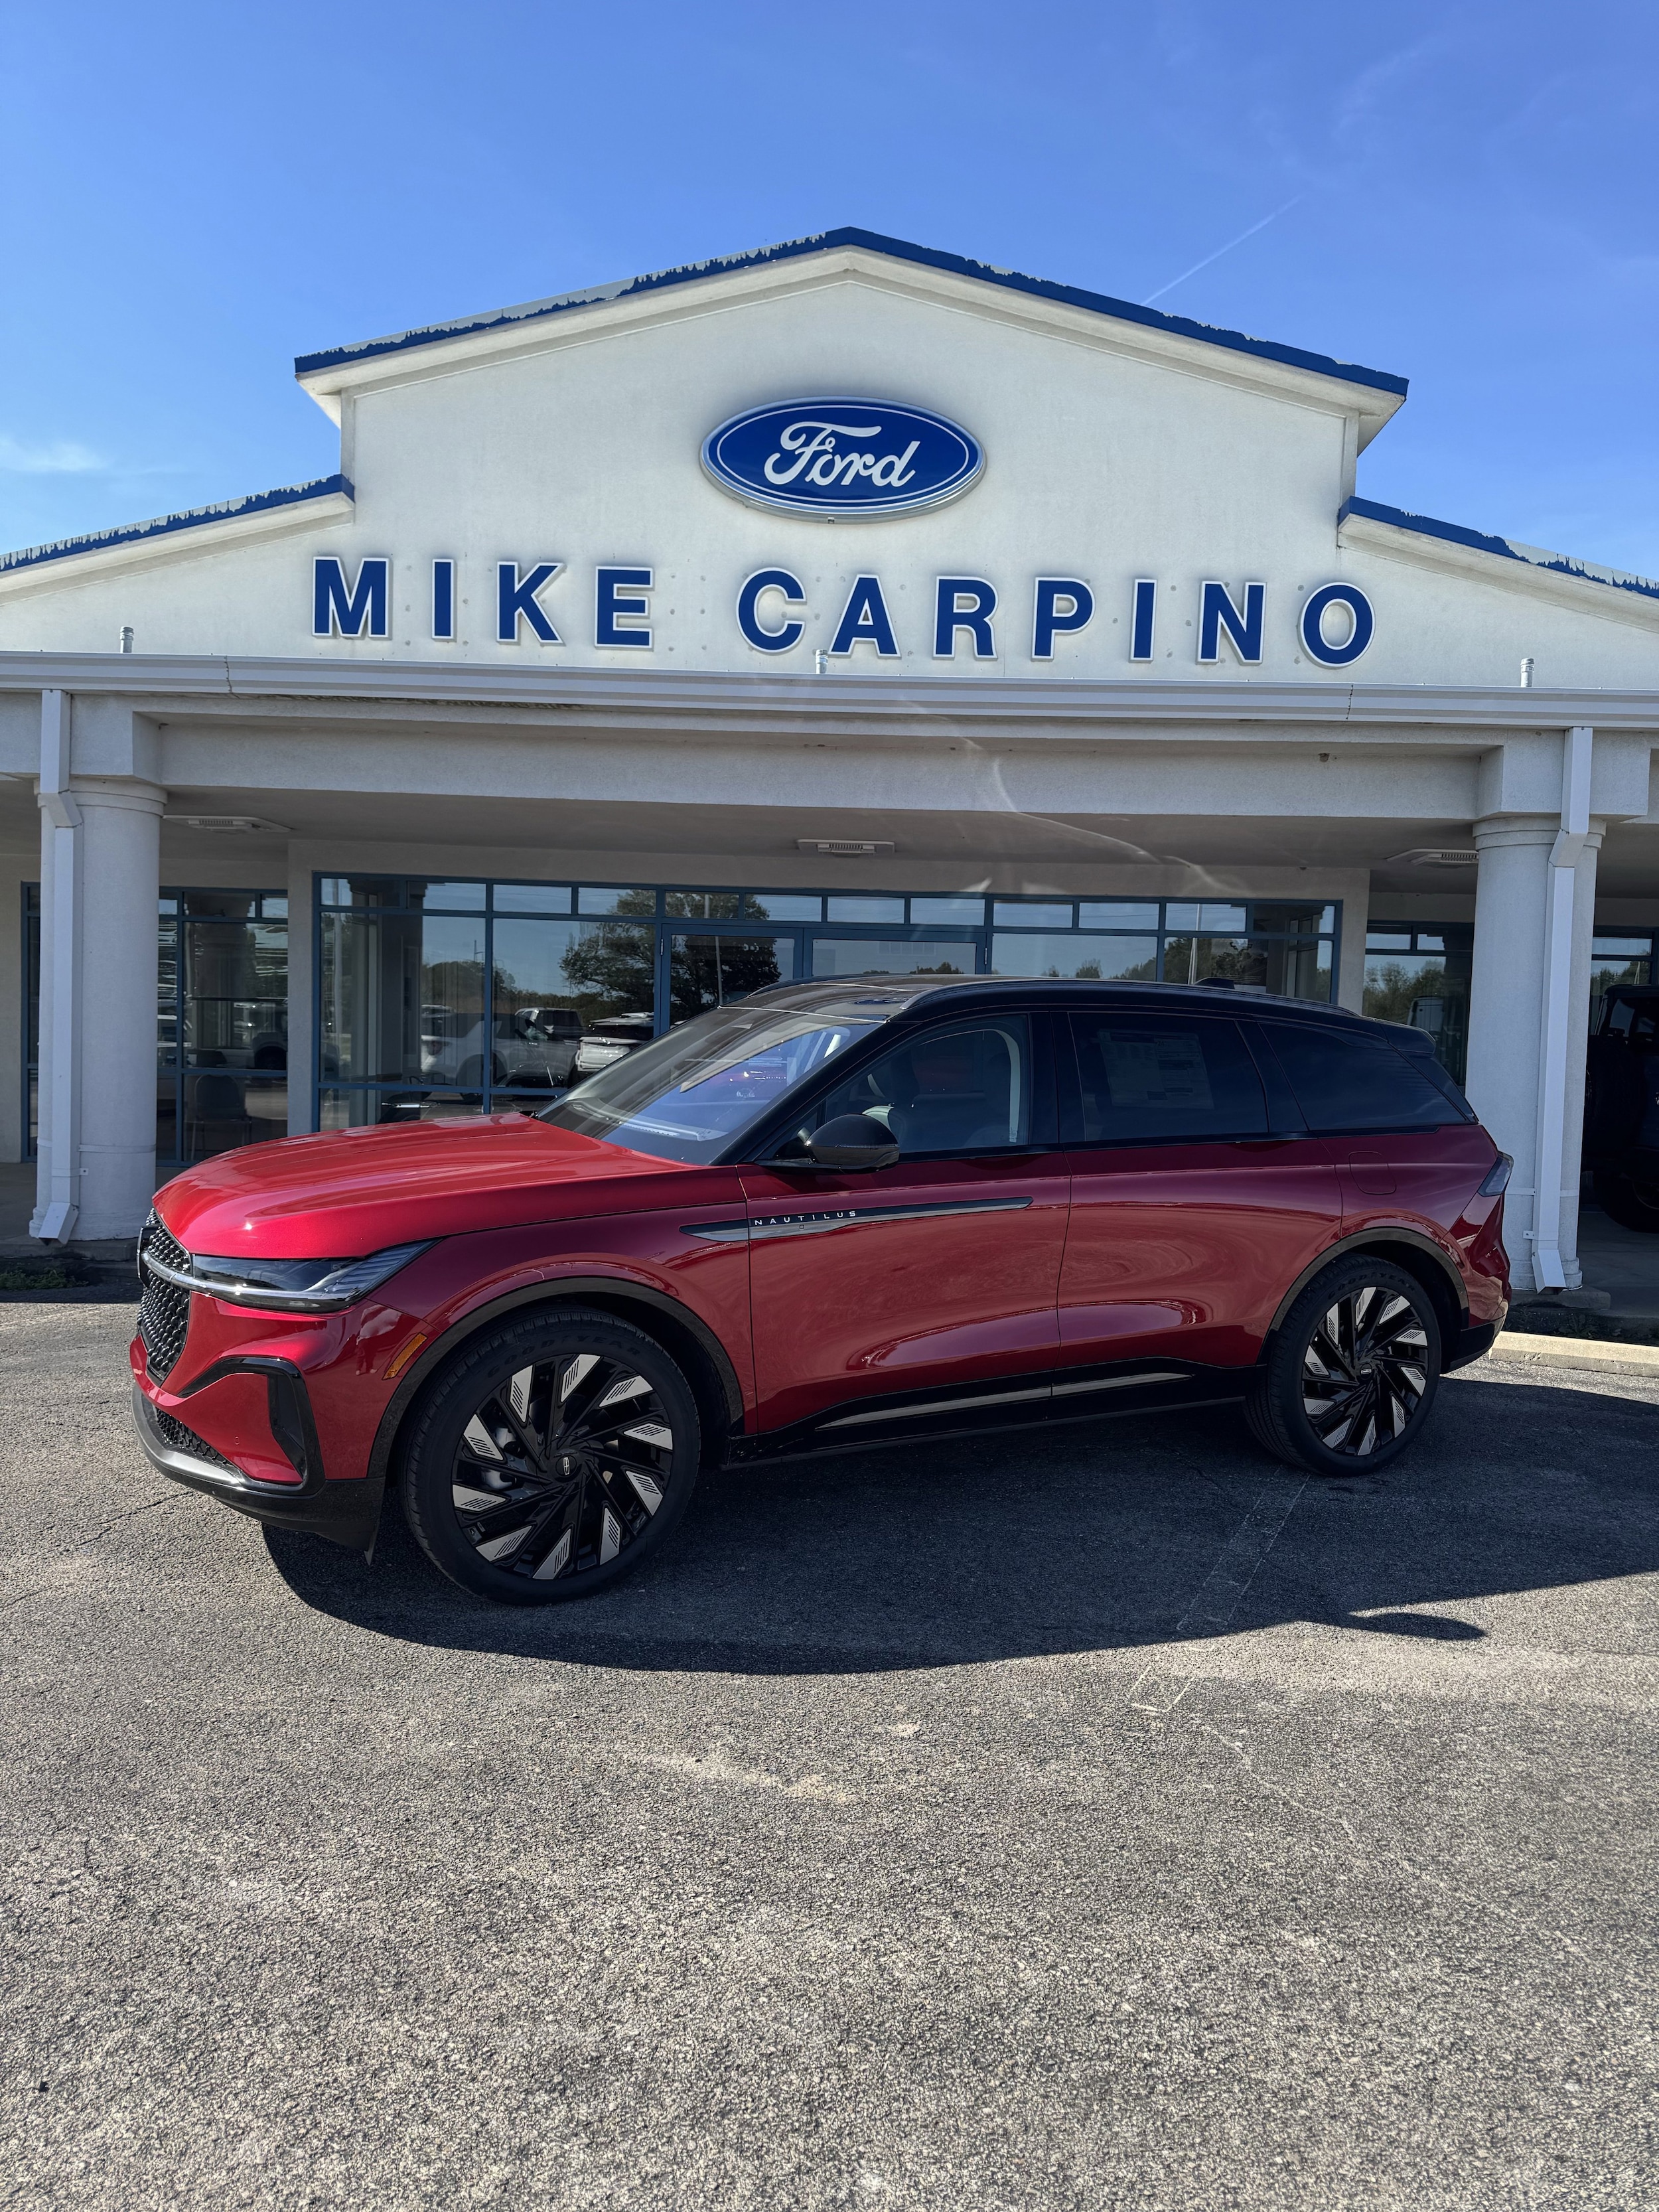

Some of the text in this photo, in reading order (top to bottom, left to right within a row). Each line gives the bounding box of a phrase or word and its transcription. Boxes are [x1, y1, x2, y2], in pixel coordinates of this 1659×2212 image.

[764, 421, 920, 487] Ford
[312, 556, 1376, 669] MIKE CARPINO
[755, 1211, 856, 1226] NAUTILUS
